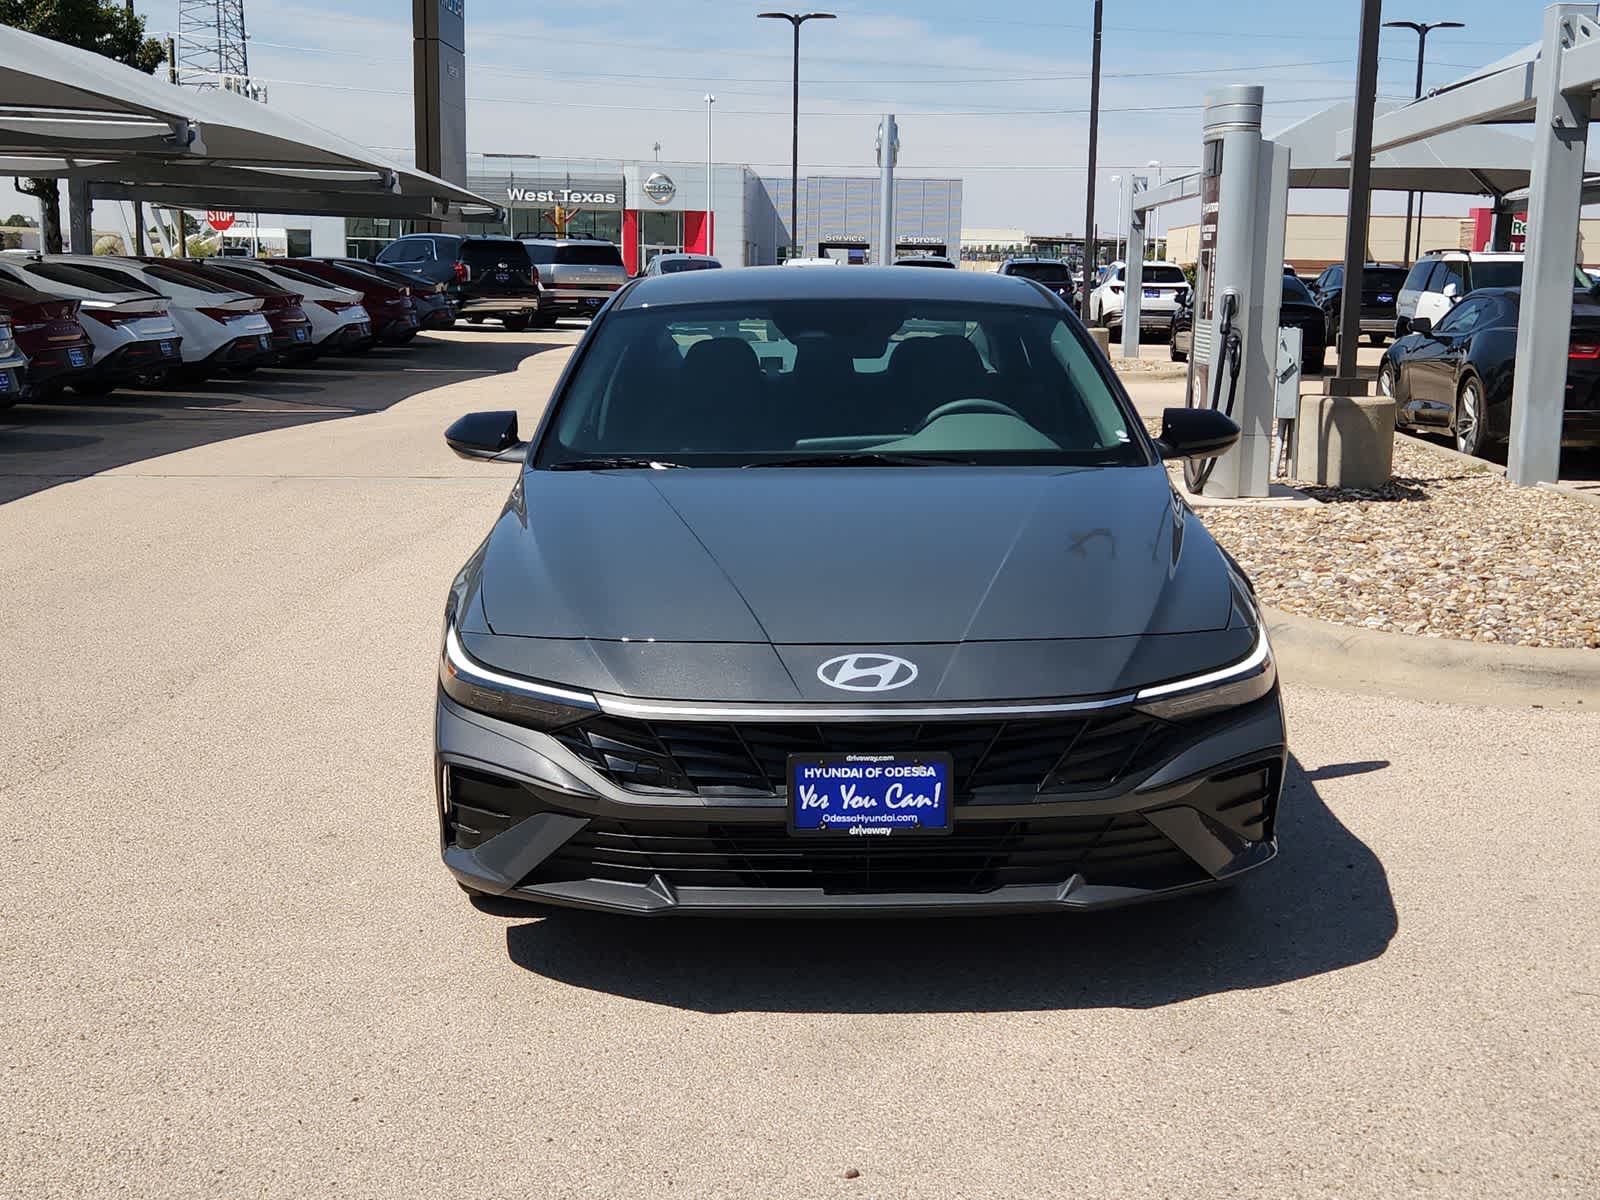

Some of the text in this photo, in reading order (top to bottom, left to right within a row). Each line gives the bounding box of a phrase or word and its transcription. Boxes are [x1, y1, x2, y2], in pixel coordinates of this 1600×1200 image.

[507, 188, 616, 204] West Texas
[208, 210, 233, 222] STOP
[825, 233, 943, 244] Service Express
[804, 766, 937, 779] HYUNDAI OF ODESSA
[799, 781, 942, 810] Yes You Can!
[822, 813, 918, 824] OdessaHyundai.com
[848, 824, 893, 836] driveway
